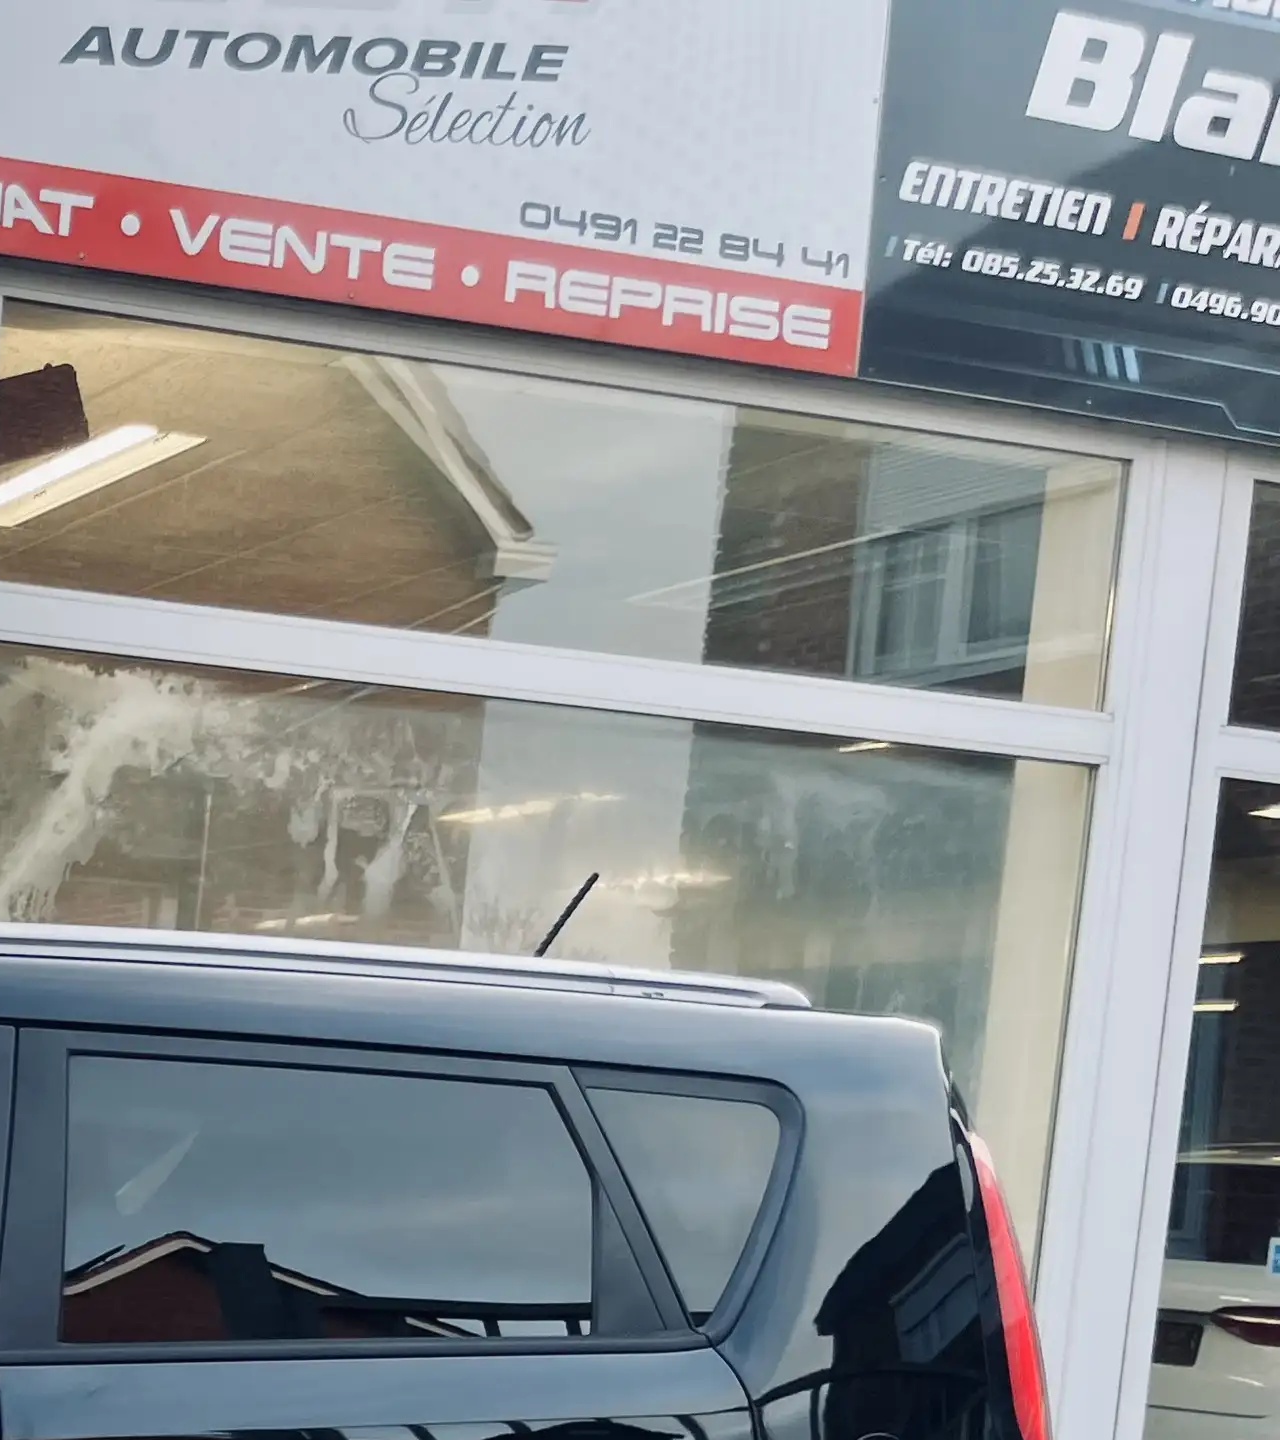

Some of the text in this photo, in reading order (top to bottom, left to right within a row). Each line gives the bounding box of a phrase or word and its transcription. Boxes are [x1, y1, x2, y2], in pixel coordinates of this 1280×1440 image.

[60, 26, 569, 81] AUTOMOBILE
[1025, 12, 1280, 166] Bla
[342, 72, 591, 148] Sélection
[520, 201, 849, 279] 0491 22 84 41
[899, 161, 1280, 269] ENTRETIEN RÉPAR
[169, 208, 436, 291] VENTE
[504, 260, 831, 350] REPRISE
[903, 239, 952, 268] Tél:
[962, 248, 1143, 300] 085.25.32.69
